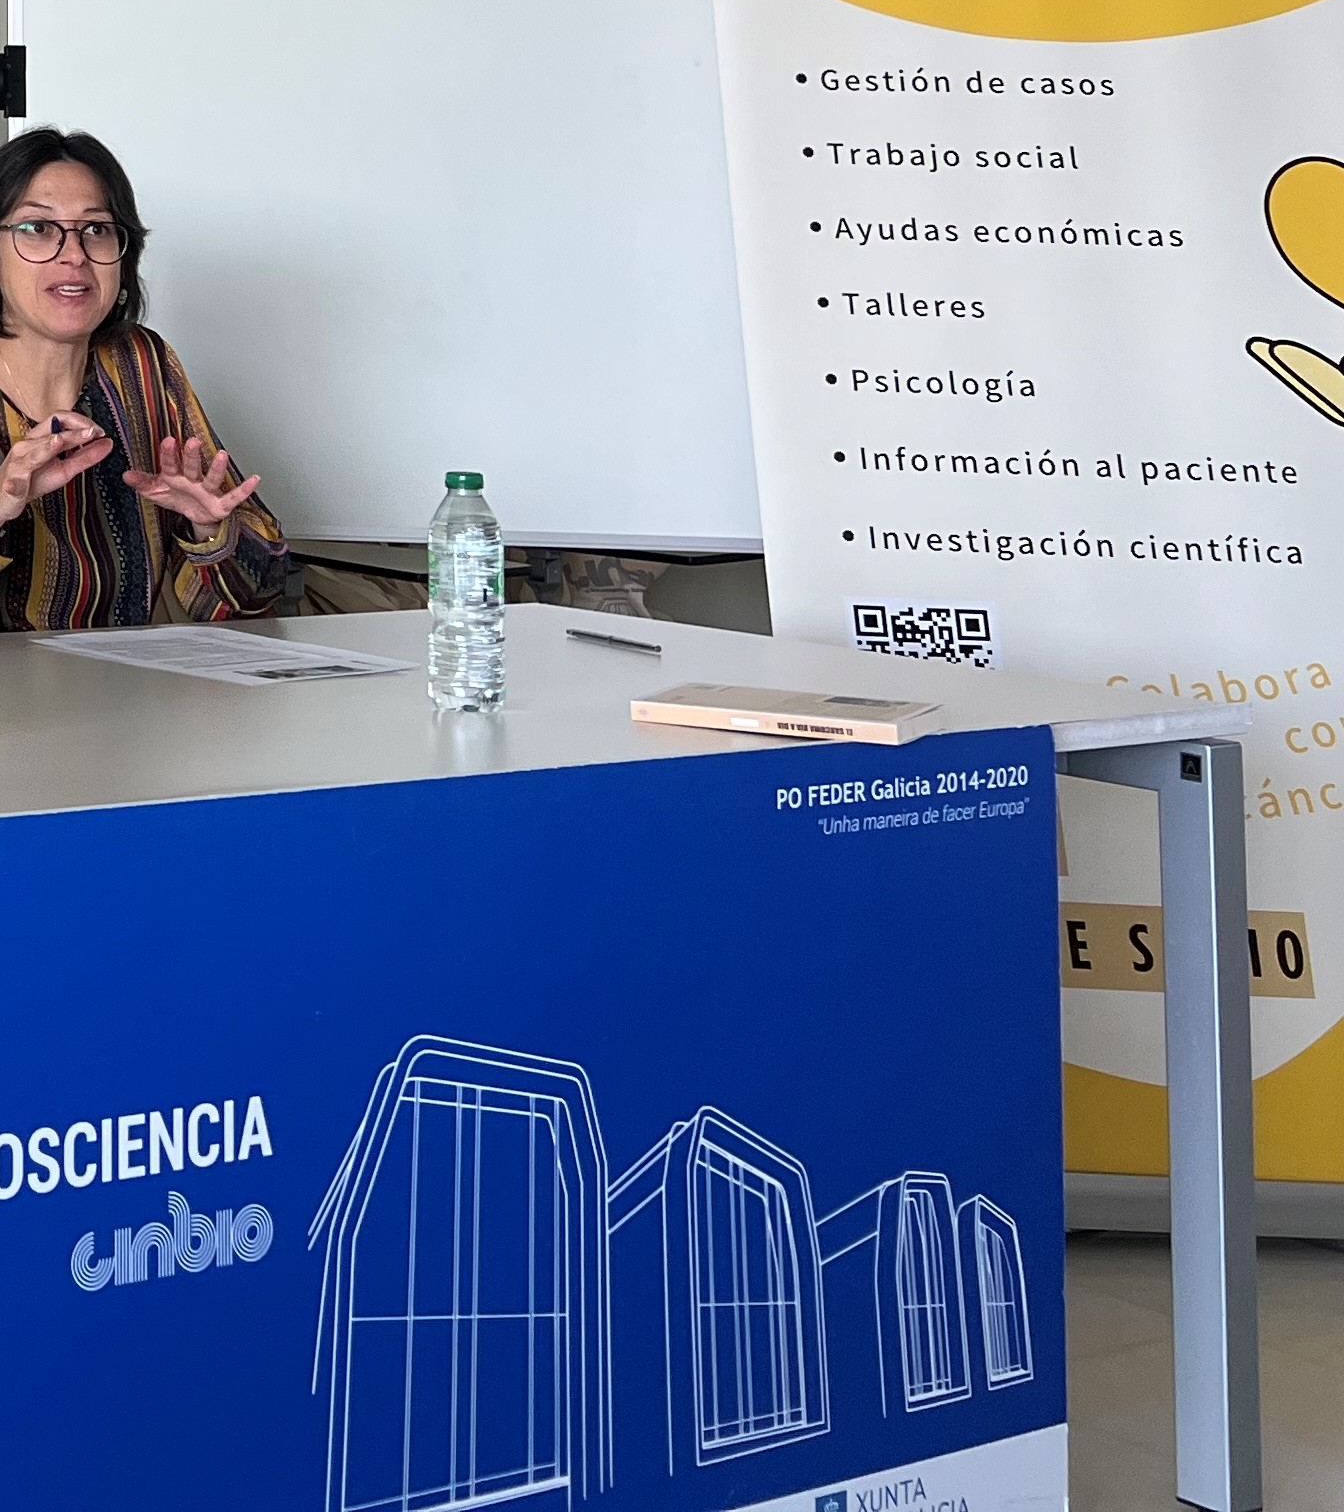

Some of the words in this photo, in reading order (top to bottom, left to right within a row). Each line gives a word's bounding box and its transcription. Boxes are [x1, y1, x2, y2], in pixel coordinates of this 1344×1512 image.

[820, 67, 951, 94] Gestión
[966, 71, 1005, 94] de
[1020, 73, 1114, 97] casos
[827, 142, 961, 173] Trabajo
[975, 145, 1079, 171] social
[834, 217, 959, 248] Ayudas
[974, 219, 1185, 249] económicas
[842, 292, 986, 320] Talleres
[851, 368, 1036, 403] Psicología
[860, 447, 1080, 478] Información
[1097, 453, 1126, 479] al
[1141, 456, 1299, 486] paciente
[868, 526, 1114, 560] Investigación
[1129, 534, 1304, 565] científica
[776, 787, 802, 810] PO
[808, 780, 866, 806] FEDER
[871, 775, 930, 800] Galicia
[936, 765, 1028, 794] 2014-2020
[863, 809, 919, 831] maneira
[922, 806, 939, 825] de
[942, 802, 976, 823] facer
[856, 1476, 926, 1512] XUNTA
